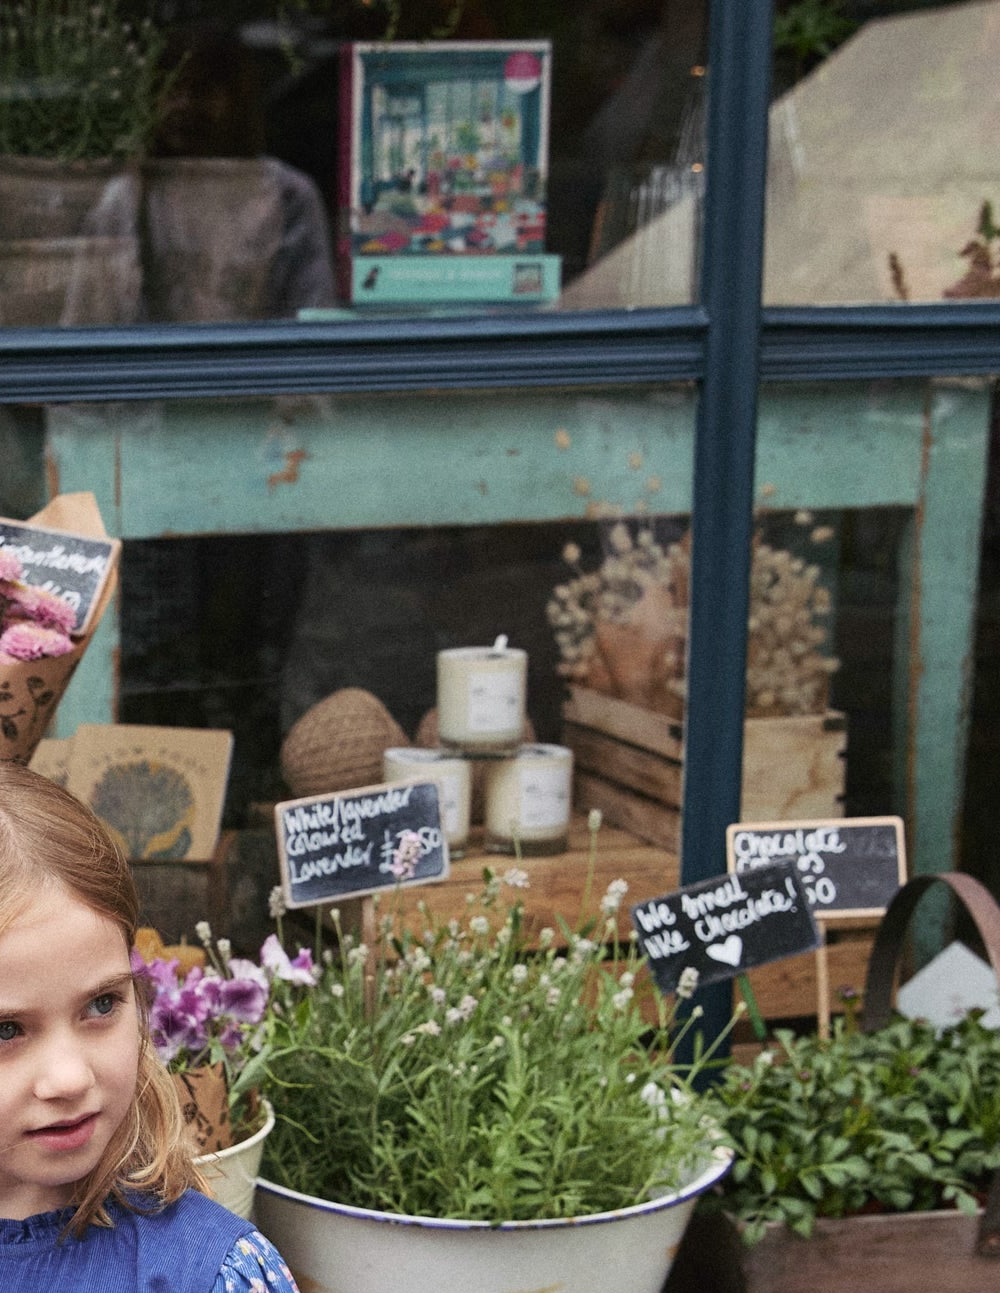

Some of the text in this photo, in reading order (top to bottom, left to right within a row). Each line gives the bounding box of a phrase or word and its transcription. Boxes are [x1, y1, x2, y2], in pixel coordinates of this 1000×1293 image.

[288, 842, 374, 884] Lavender
[636, 902, 677, 933] We
[642, 929, 691, 960] like
